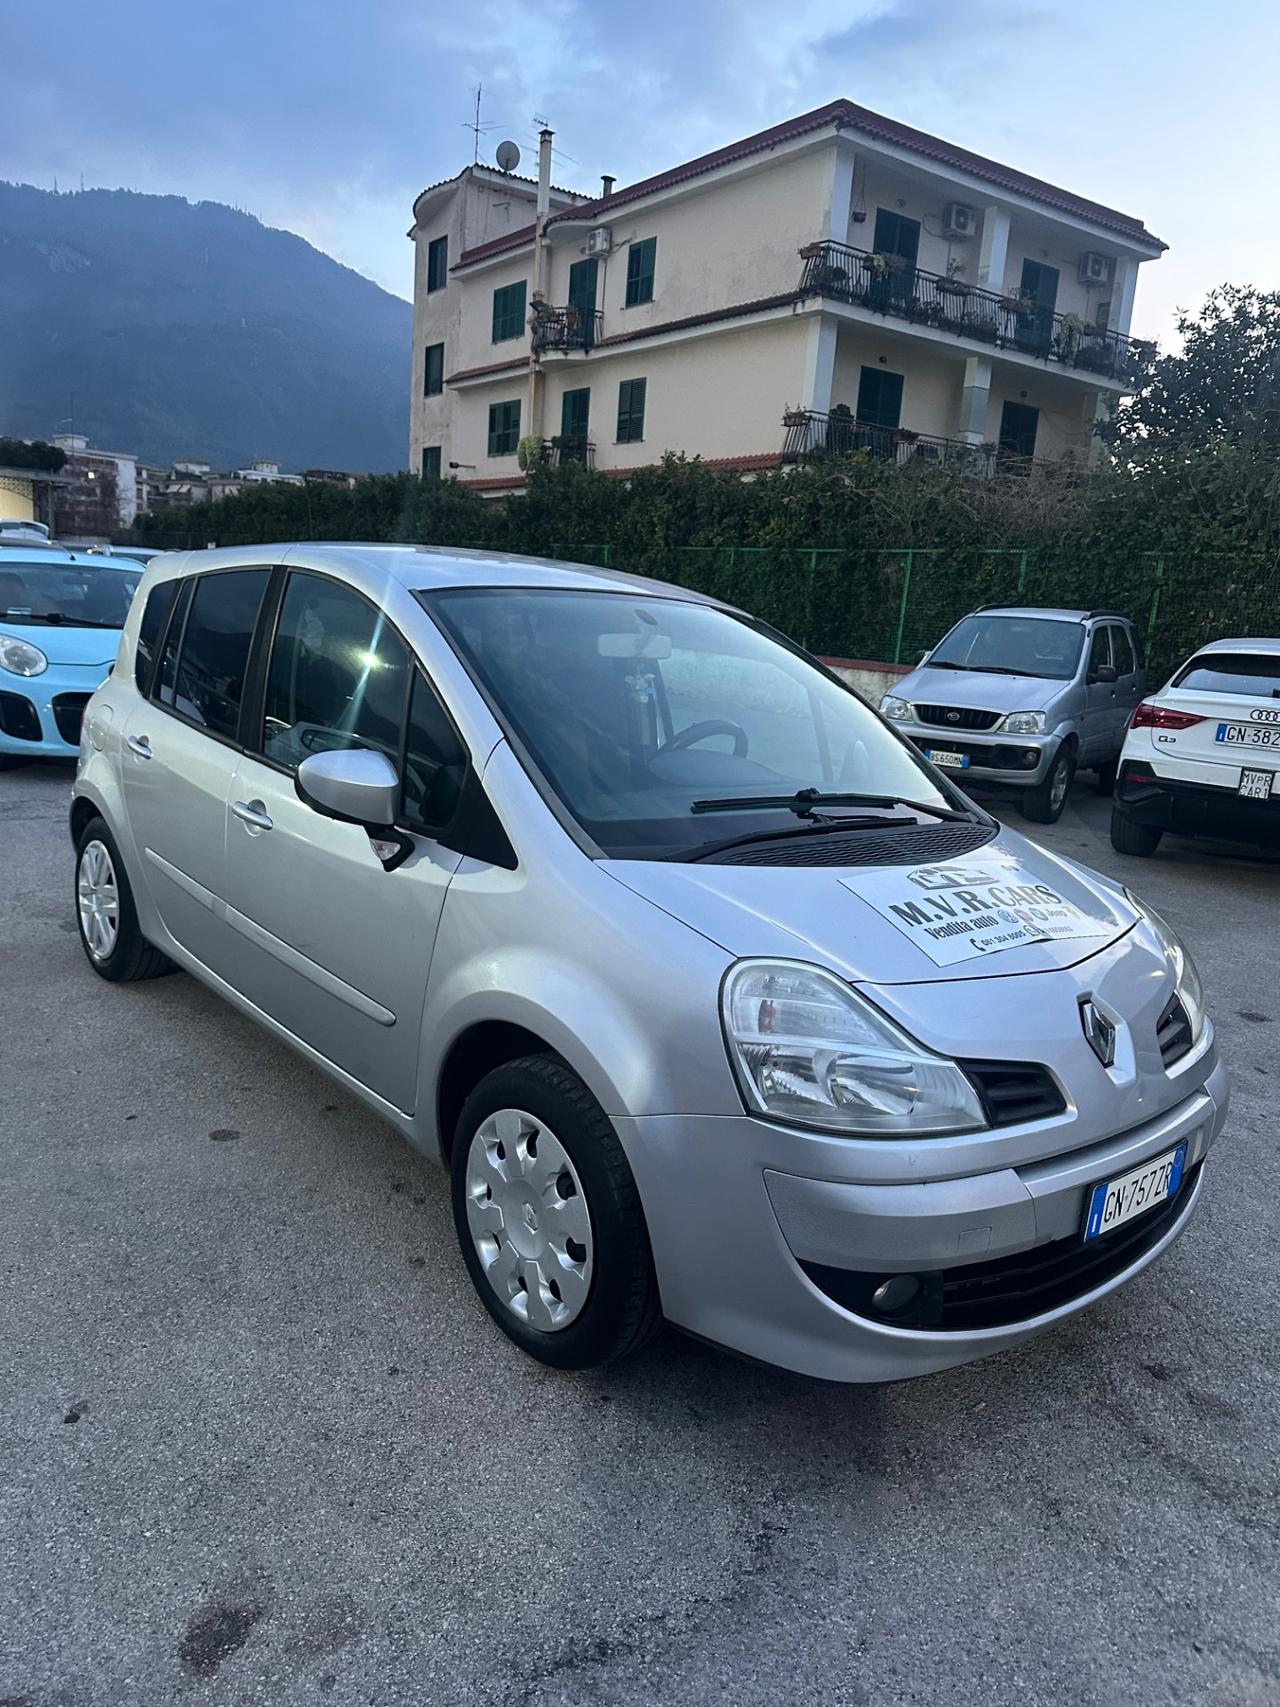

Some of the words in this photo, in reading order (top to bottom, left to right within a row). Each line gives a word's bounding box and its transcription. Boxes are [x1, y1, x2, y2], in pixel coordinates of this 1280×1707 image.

[1158, 735, 1176, 743] Q3
[923, 920, 975, 940] Vendita
[970, 915, 999, 930] auto
